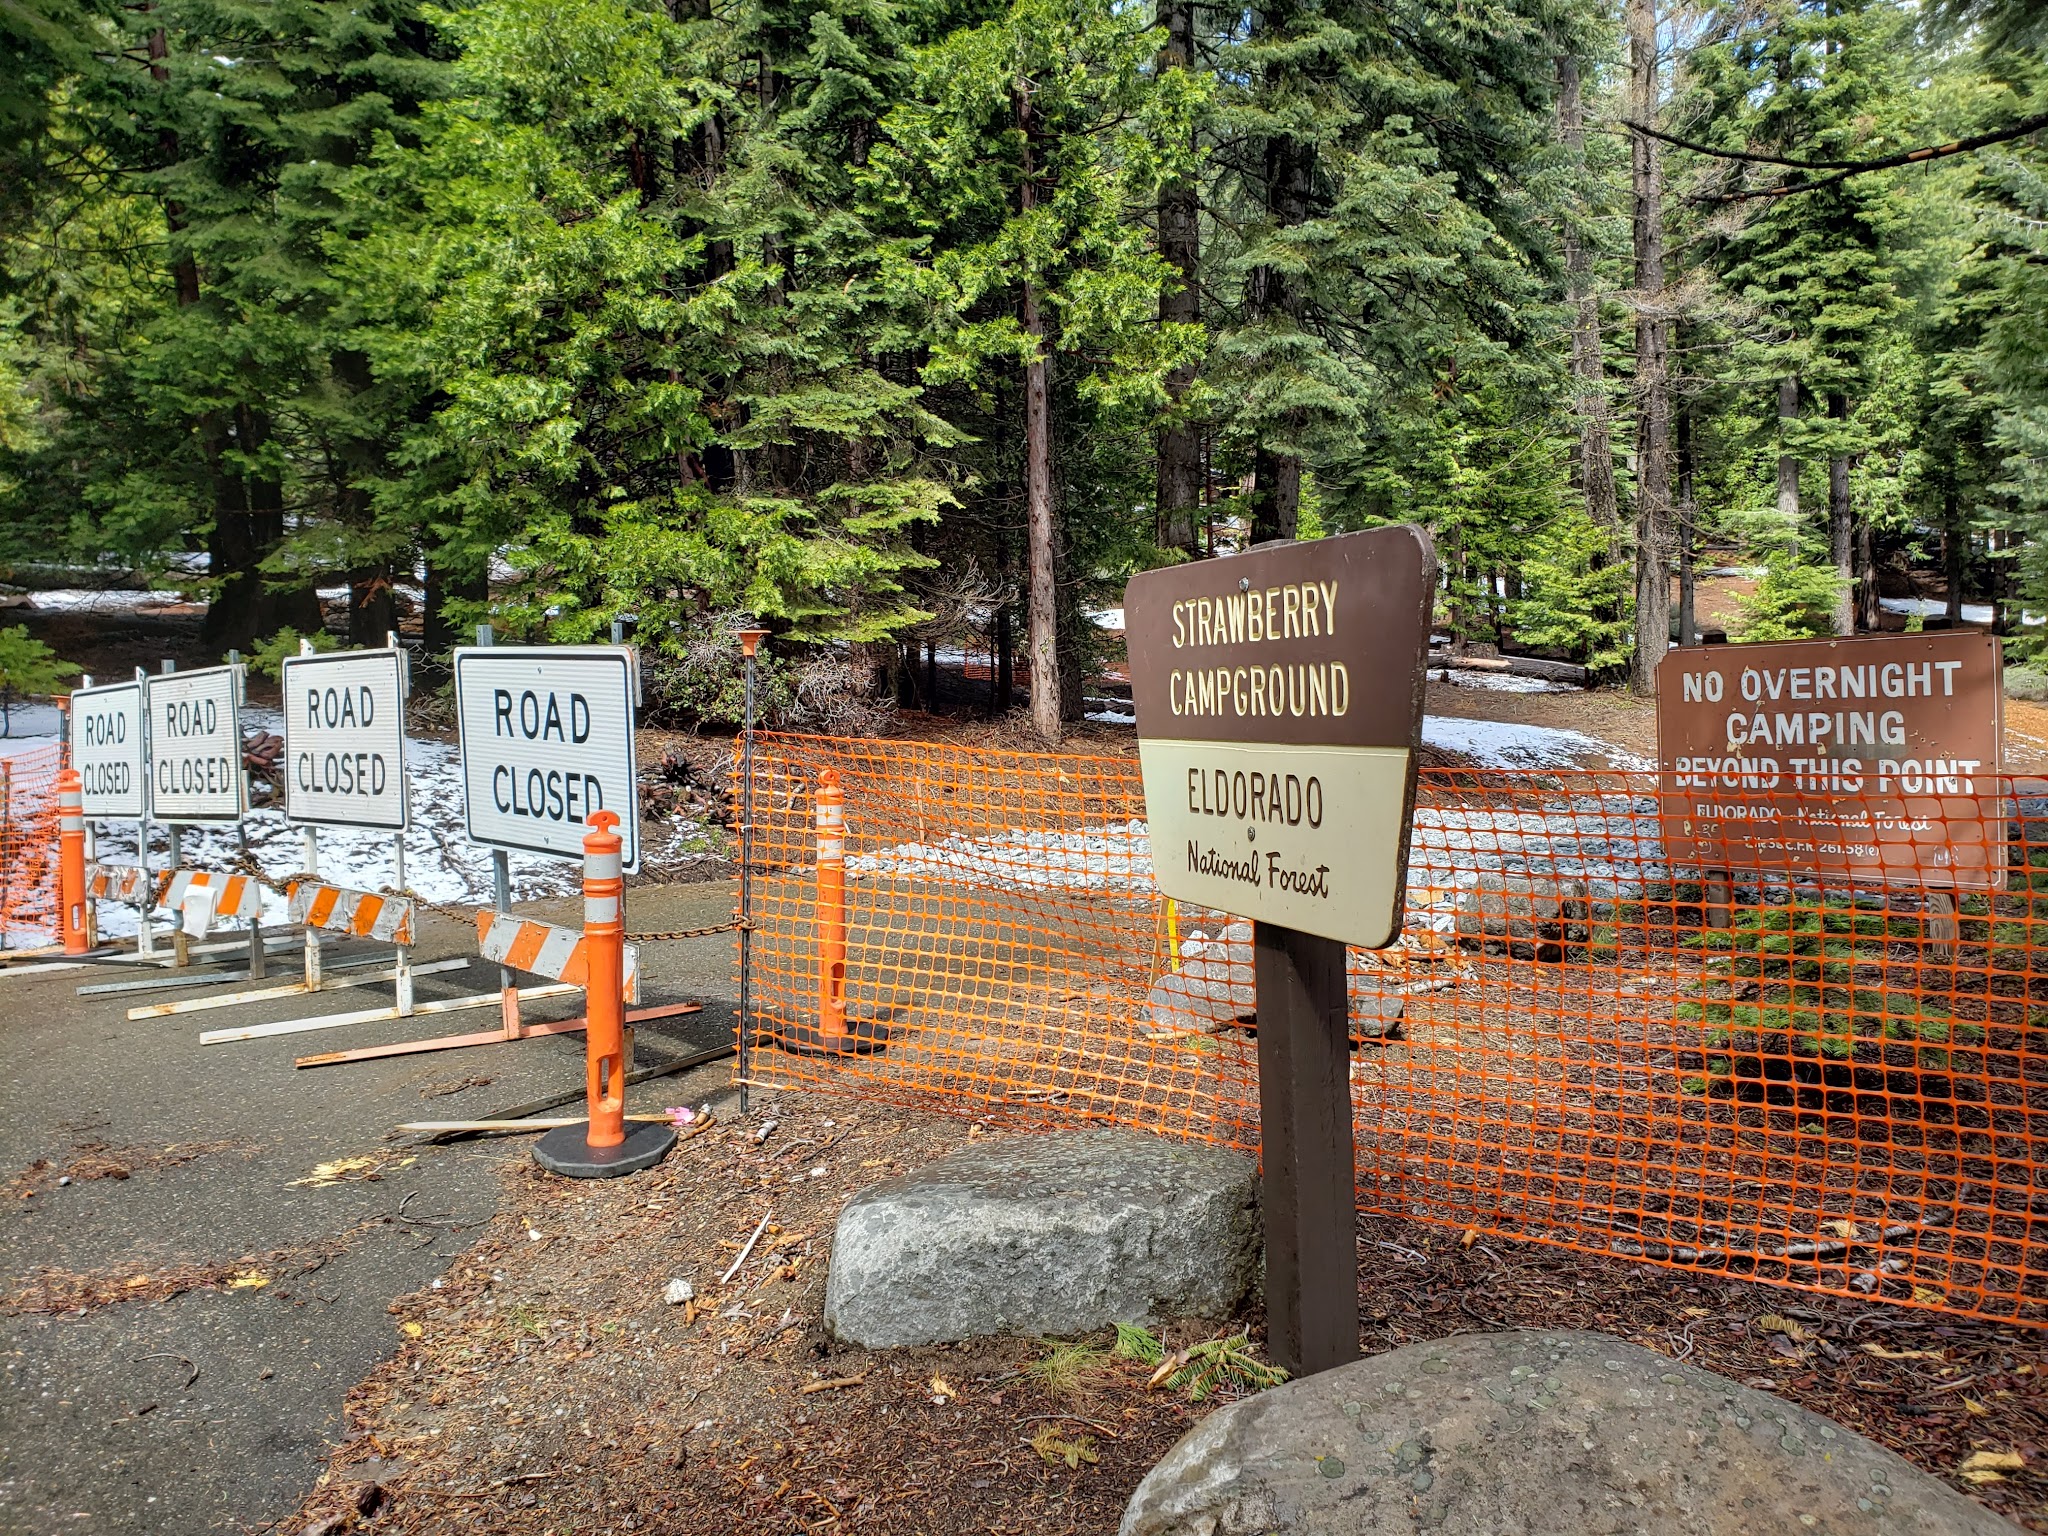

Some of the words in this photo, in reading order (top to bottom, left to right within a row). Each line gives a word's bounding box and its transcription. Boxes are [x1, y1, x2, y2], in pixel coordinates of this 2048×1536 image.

[1172, 579, 1338, 649] STRAWBERRY
[1170, 661, 1349, 717] CAMPGROUND
[1683, 670, 1723, 703] NO
[1741, 660, 1962, 701] OVERNIGHT
[86, 711, 126, 746] ROAD
[167, 698, 216, 738] ROAD
[308, 686, 374, 729] ROAD
[494, 689, 590, 744] ROAD
[1726, 710, 1905, 745] CAMPING
[84, 761, 130, 795] CLOSED
[159, 757, 231, 794] CLOSED
[299, 752, 386, 796] CLOSED
[493, 764, 603, 825] CLOSED
[1675, 757, 1779, 789] BEYOND
[1789, 758, 1863, 792] THIS
[1878, 759, 1980, 794] POINT
[1188, 768, 1323, 829] ELDORADO
[1187, 840, 1260, 887] National
[1267, 851, 1330, 898] Forest
